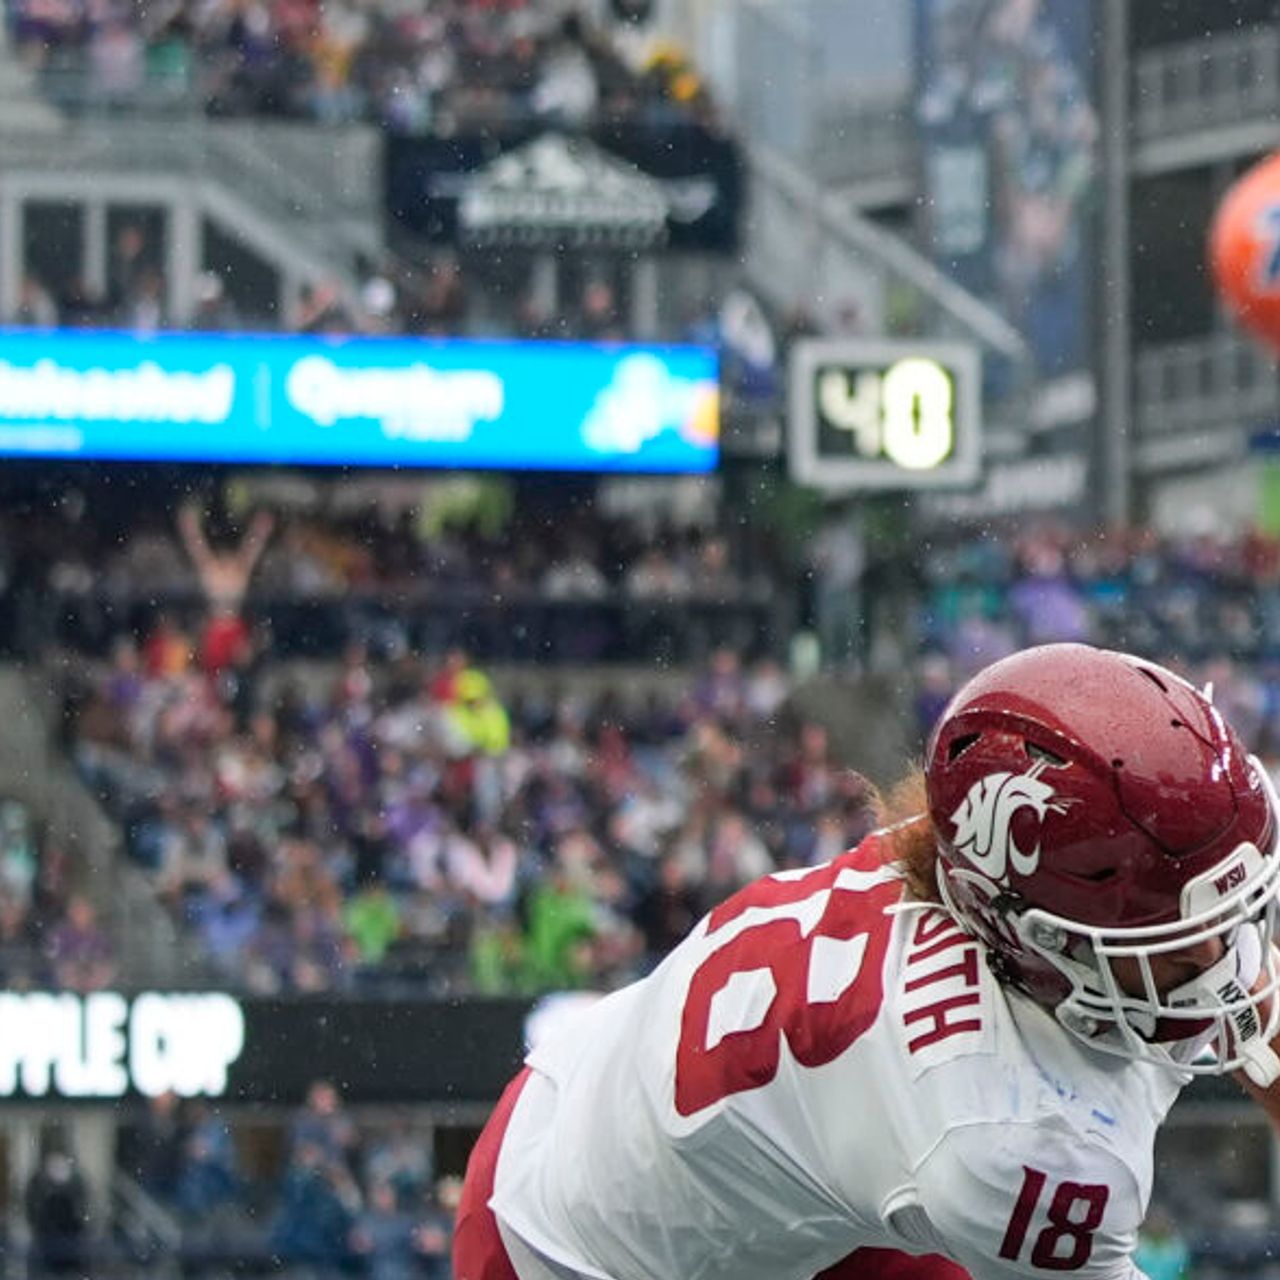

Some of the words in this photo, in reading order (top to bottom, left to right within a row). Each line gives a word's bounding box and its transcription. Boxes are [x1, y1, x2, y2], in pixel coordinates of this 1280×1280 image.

[820, 358, 952, 470] 40
[1214, 862, 1247, 896] WSU
[129, 990, 244, 1096] CUP
[998, 1164, 1110, 1271] 18
